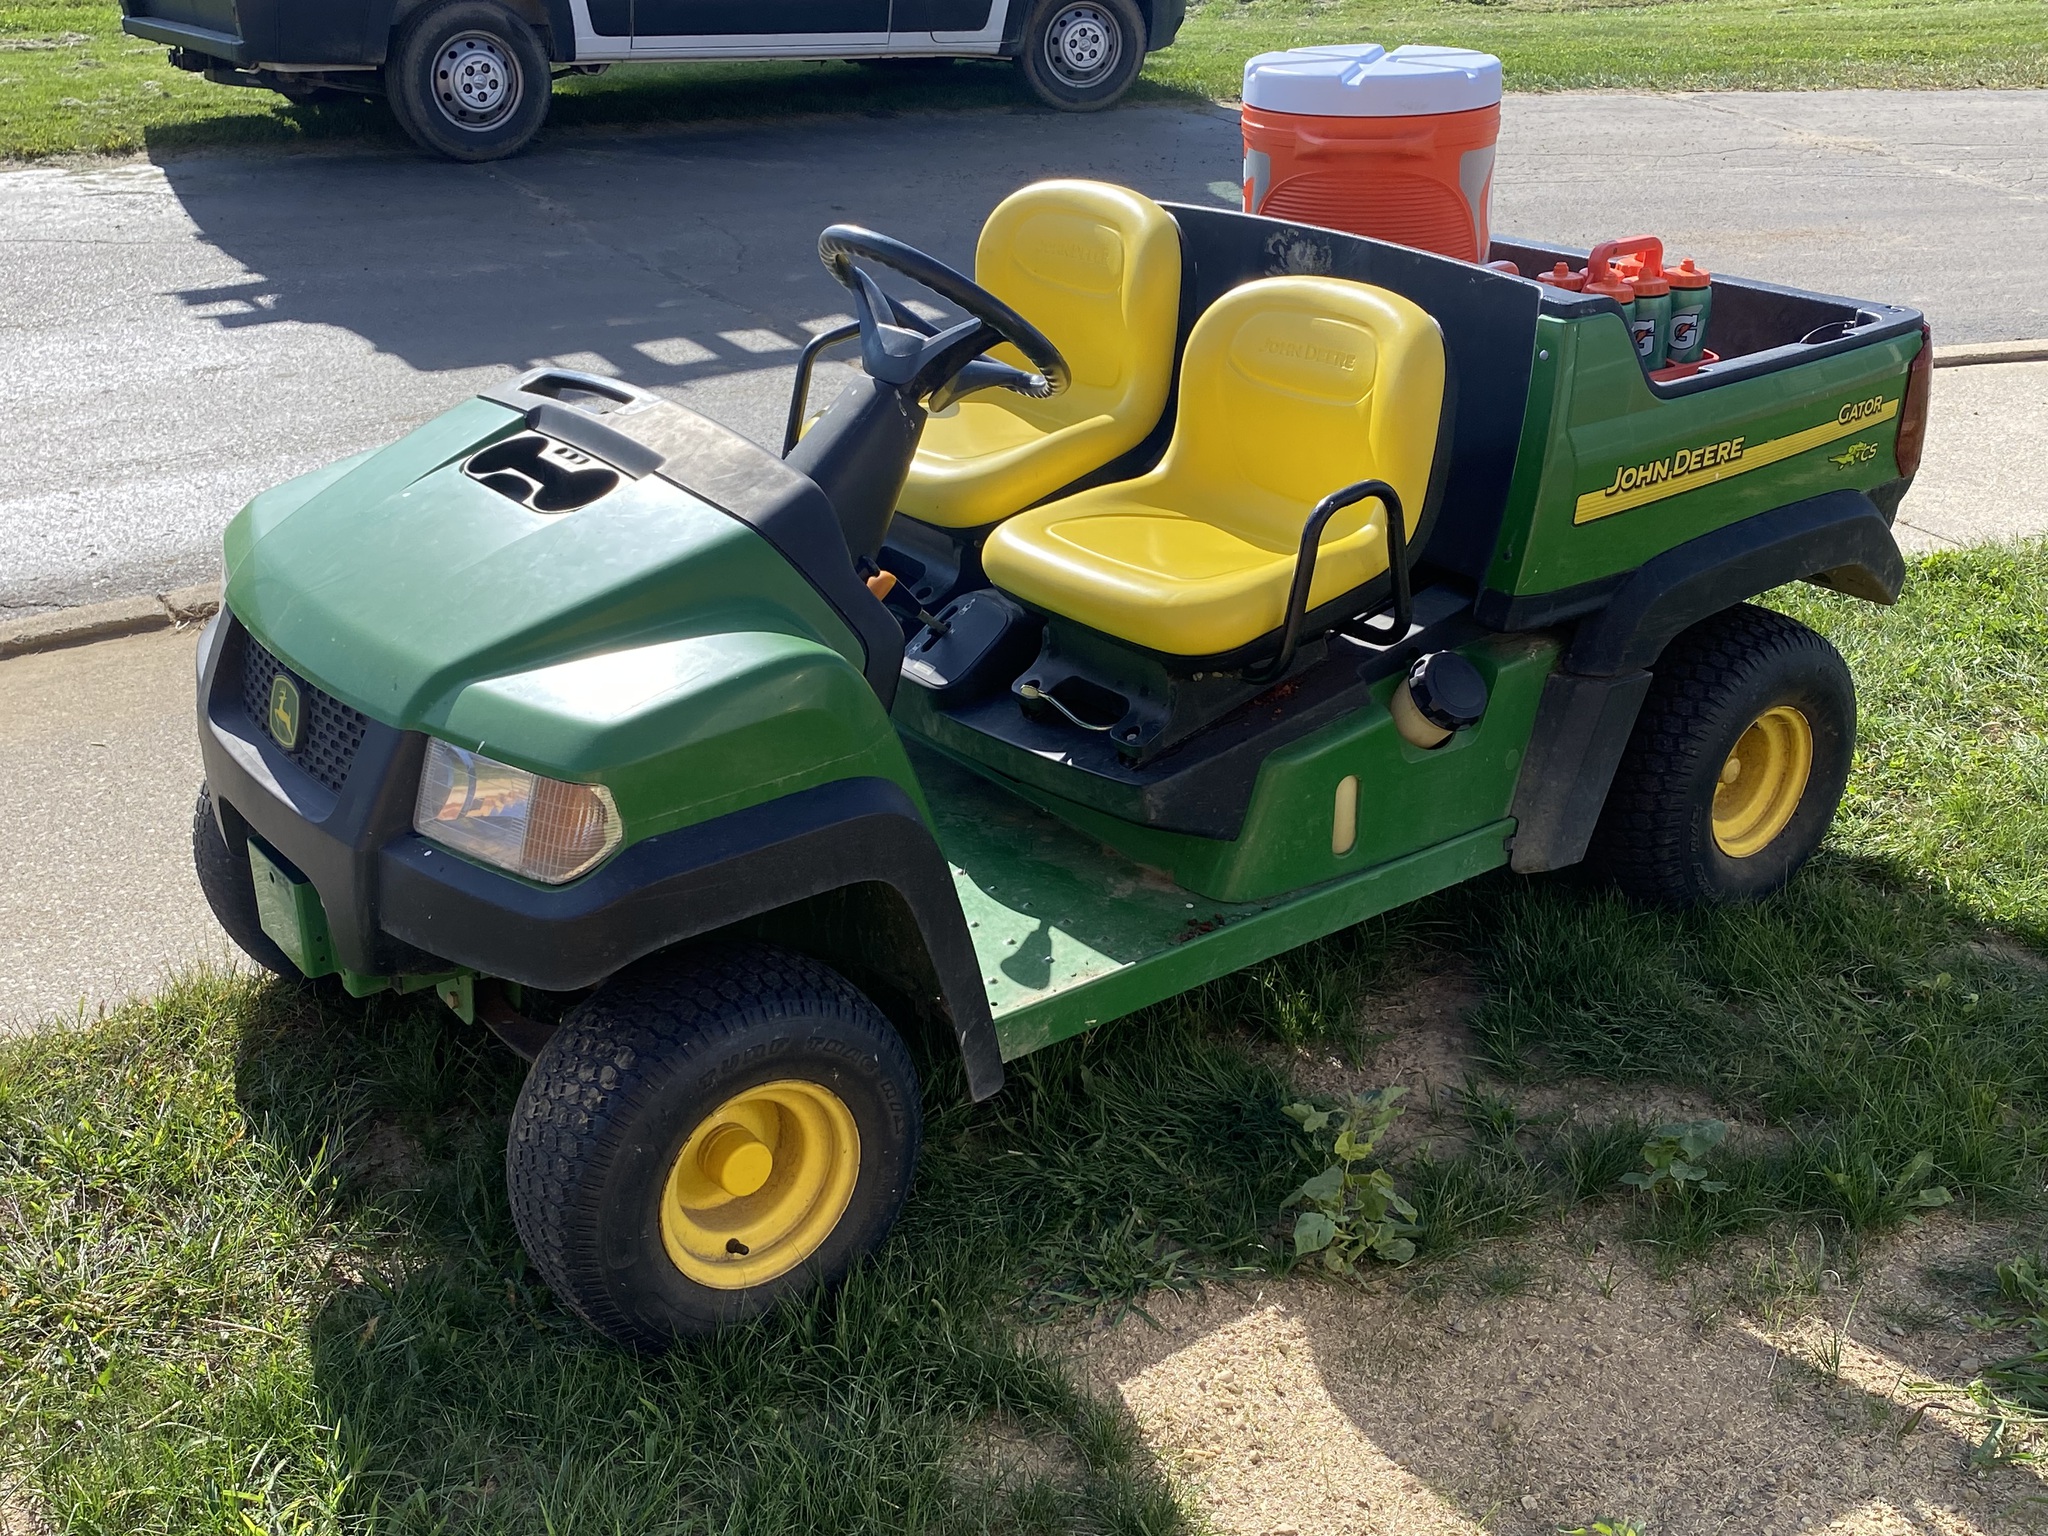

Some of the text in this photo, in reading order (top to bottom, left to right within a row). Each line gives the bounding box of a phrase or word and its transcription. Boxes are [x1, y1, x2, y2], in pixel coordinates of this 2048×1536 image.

[1668, 314, 1699, 351] G
[1258, 338, 1356, 371] JOHN DEERE
[1838, 395, 1883, 424] GATOR
[1604, 436, 1745, 496] JOHN DEERE
[1860, 442, 1879, 462] CS
